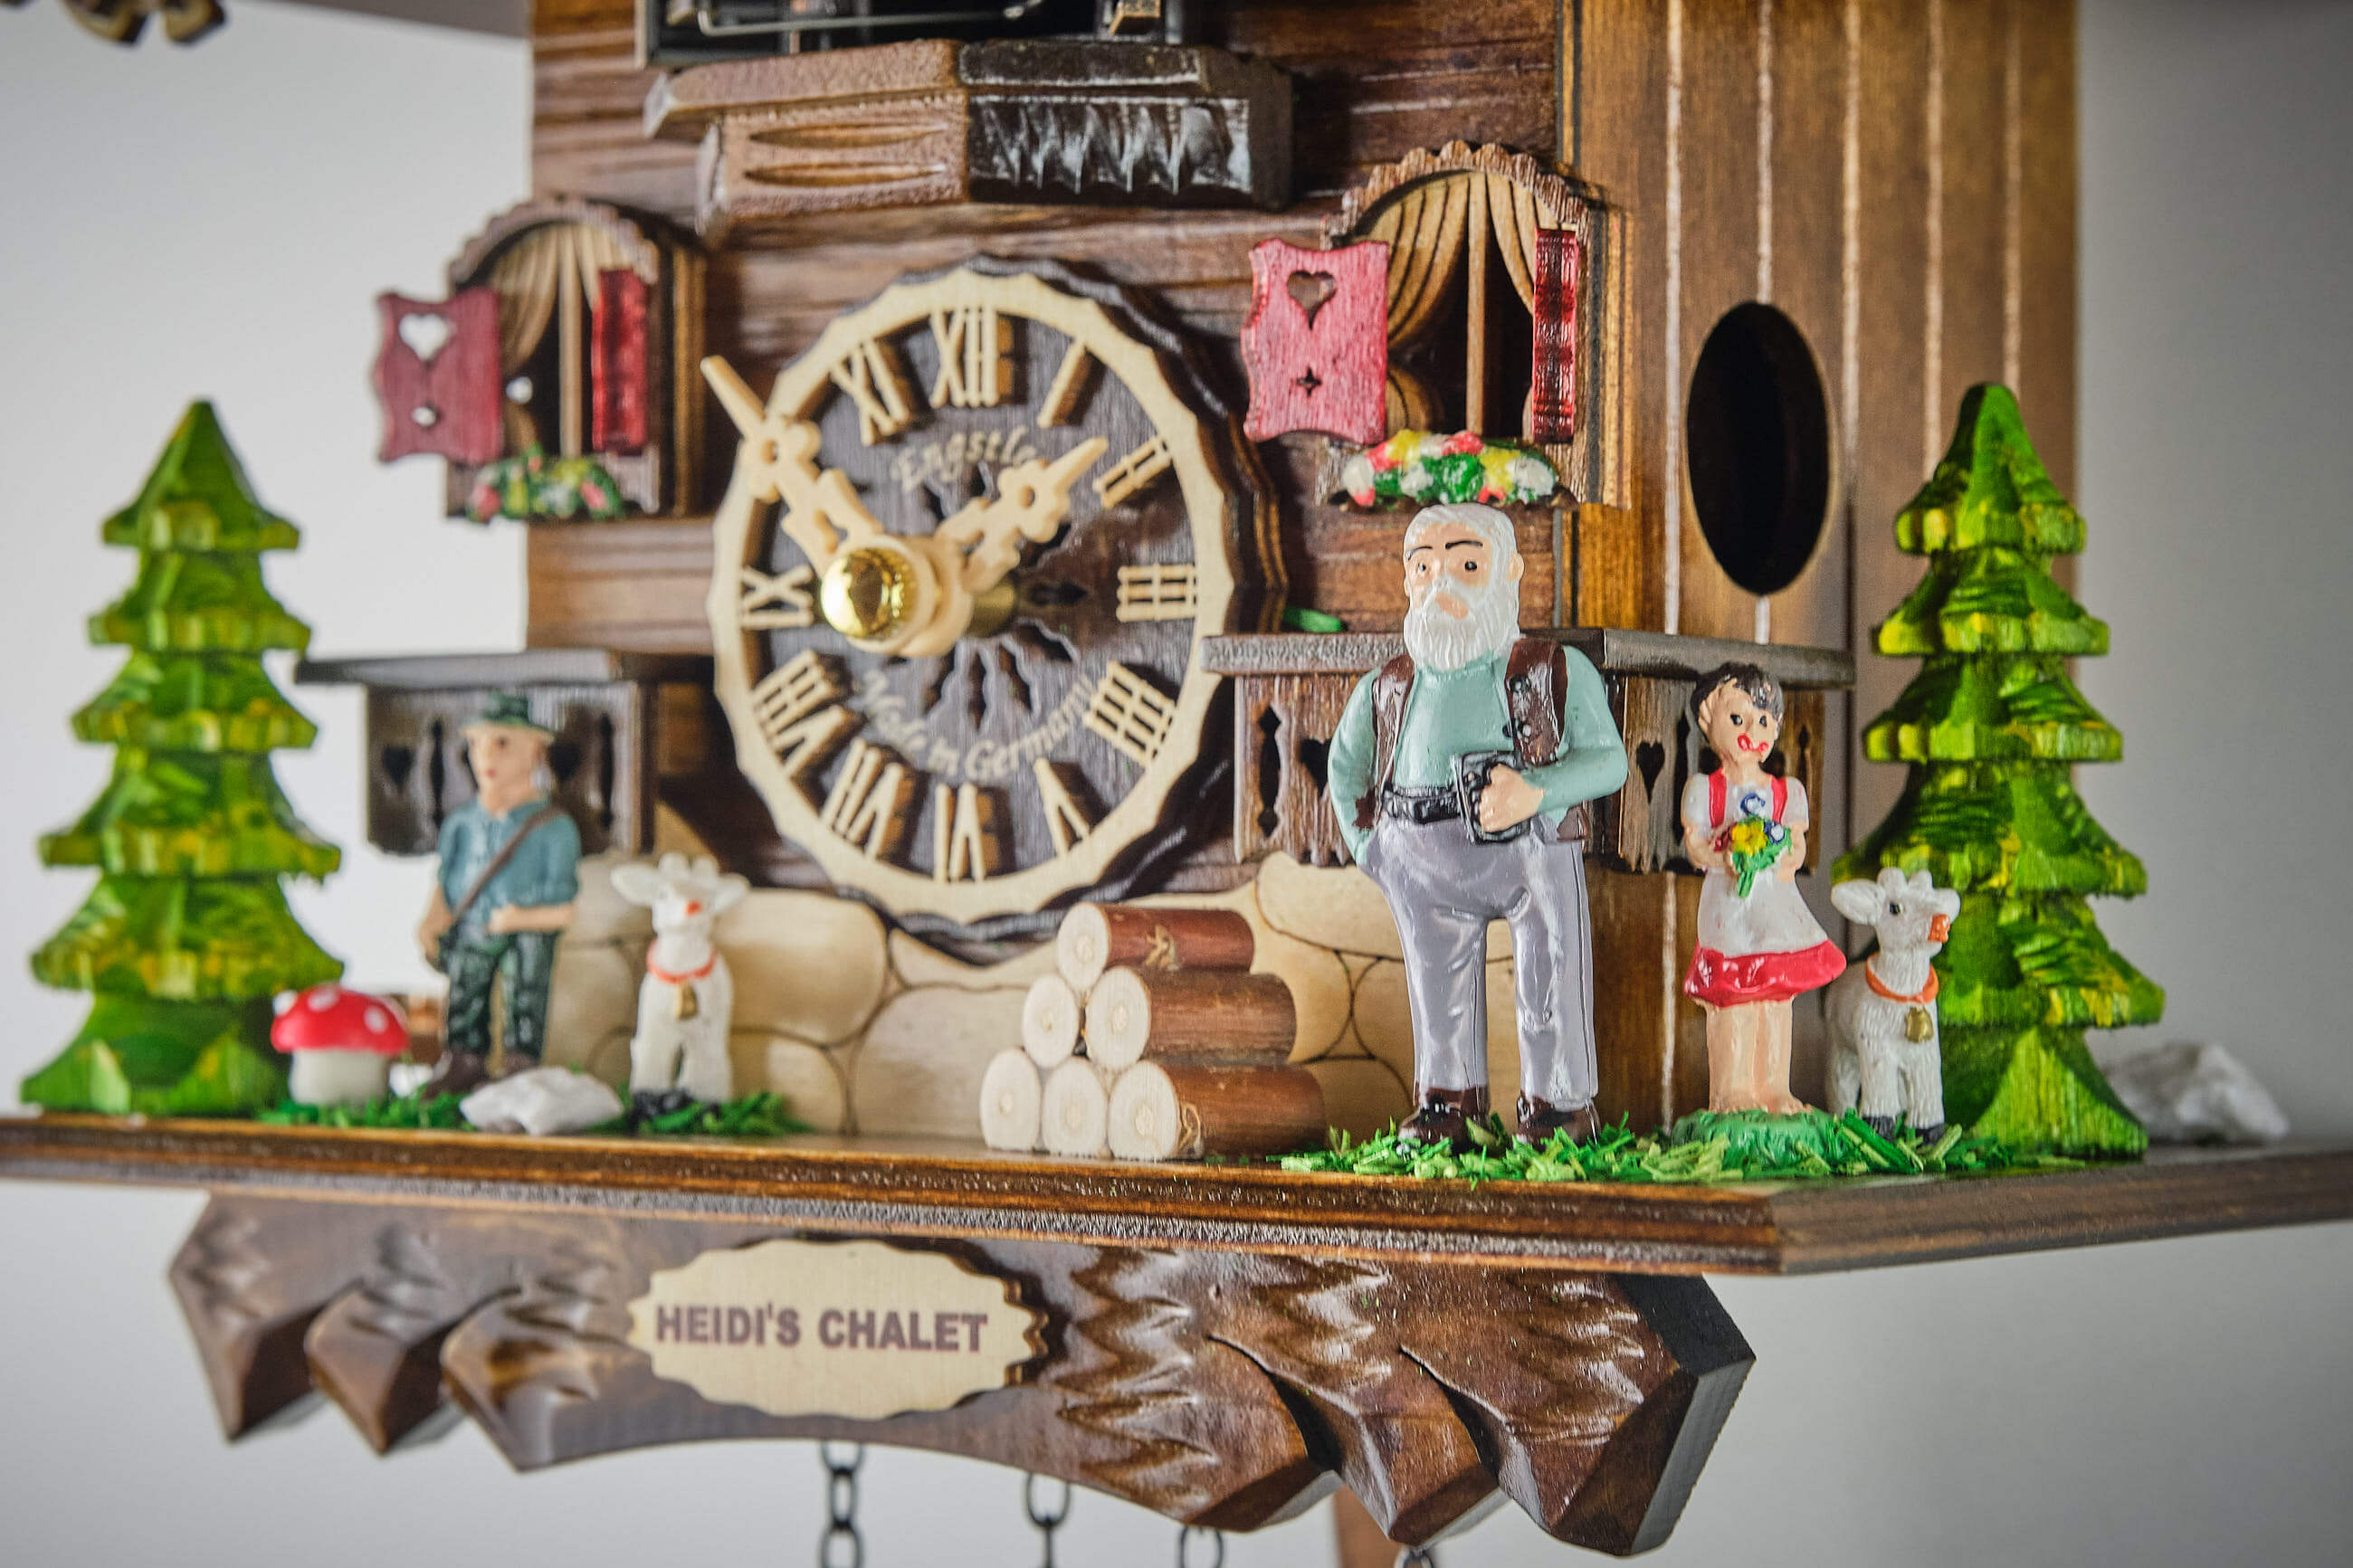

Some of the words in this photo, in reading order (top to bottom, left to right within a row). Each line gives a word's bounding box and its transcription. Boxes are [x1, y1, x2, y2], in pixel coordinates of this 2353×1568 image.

[828, 339, 909, 445] XI
[929, 307, 999, 408] XII
[1092, 436, 1173, 509] II
[740, 565, 814, 629] IX
[1117, 564, 1194, 622] III
[1085, 660, 1177, 768] IIII
[819, 736, 904, 858] VII
[933, 783, 986, 883] VI
[1033, 757, 1090, 857] V
[656, 1303, 801, 1345] HEIDI'S
[817, 1308, 988, 1353] CHALET
